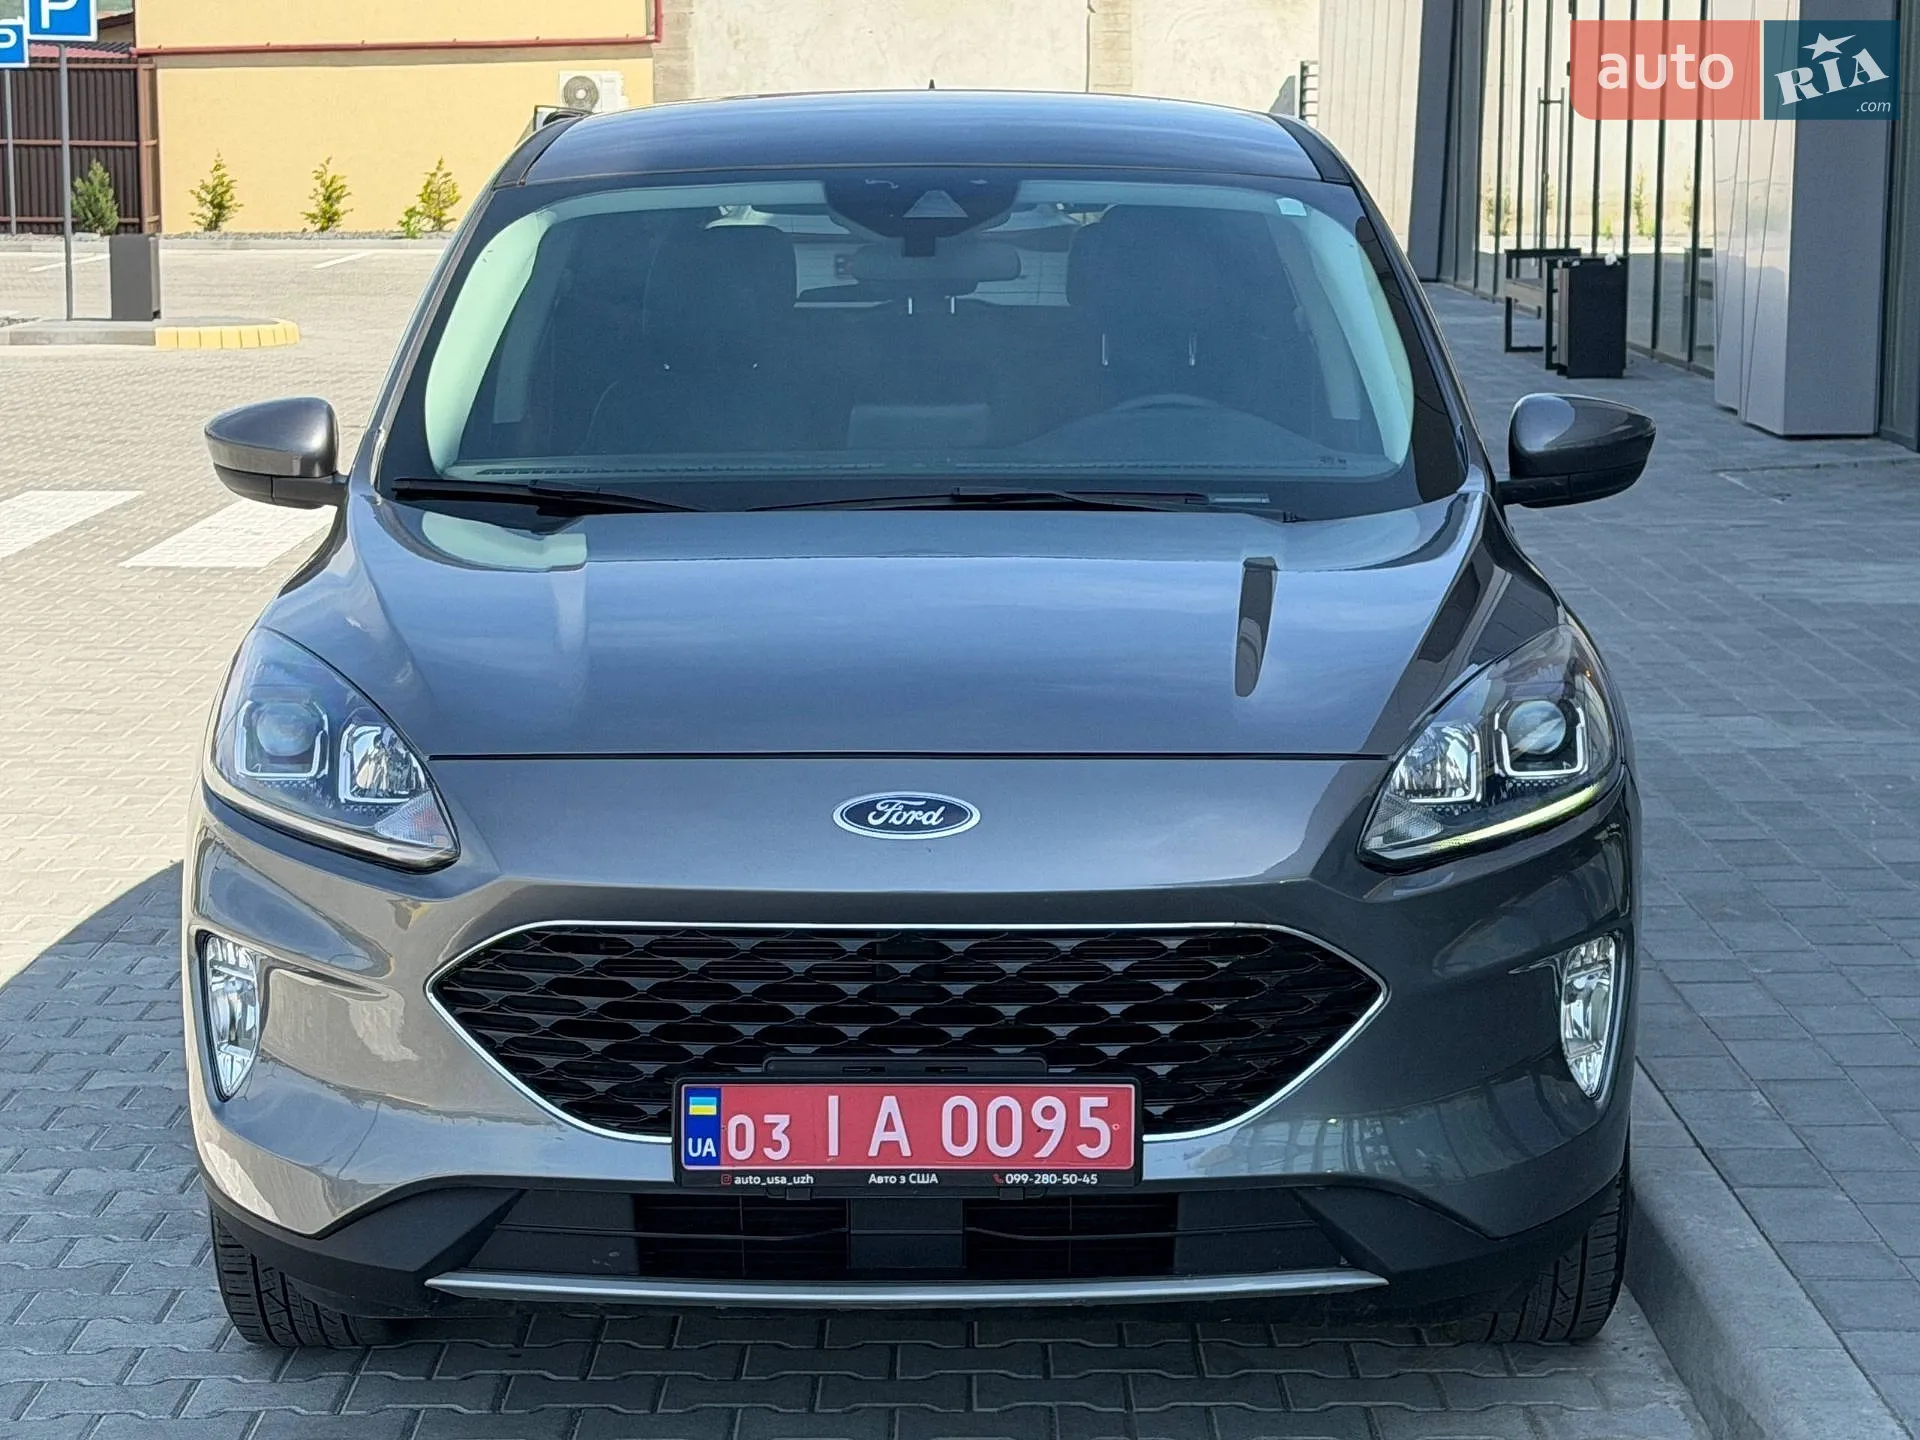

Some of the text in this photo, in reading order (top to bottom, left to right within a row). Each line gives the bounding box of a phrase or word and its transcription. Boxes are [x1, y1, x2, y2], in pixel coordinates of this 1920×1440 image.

[867, 800, 945, 825] Ford
[727, 1114, 791, 1160] 03
[941, 1095, 1112, 1158] 0095
[688, 1137, 717, 1158] UA
[734, 1173, 814, 1187] auto_usa_uzh
[868, 1173, 898, 1185] Авто
[909, 1173, 938, 1185] США
[1005, 1173, 1098, 1185] 099-280-50-45
